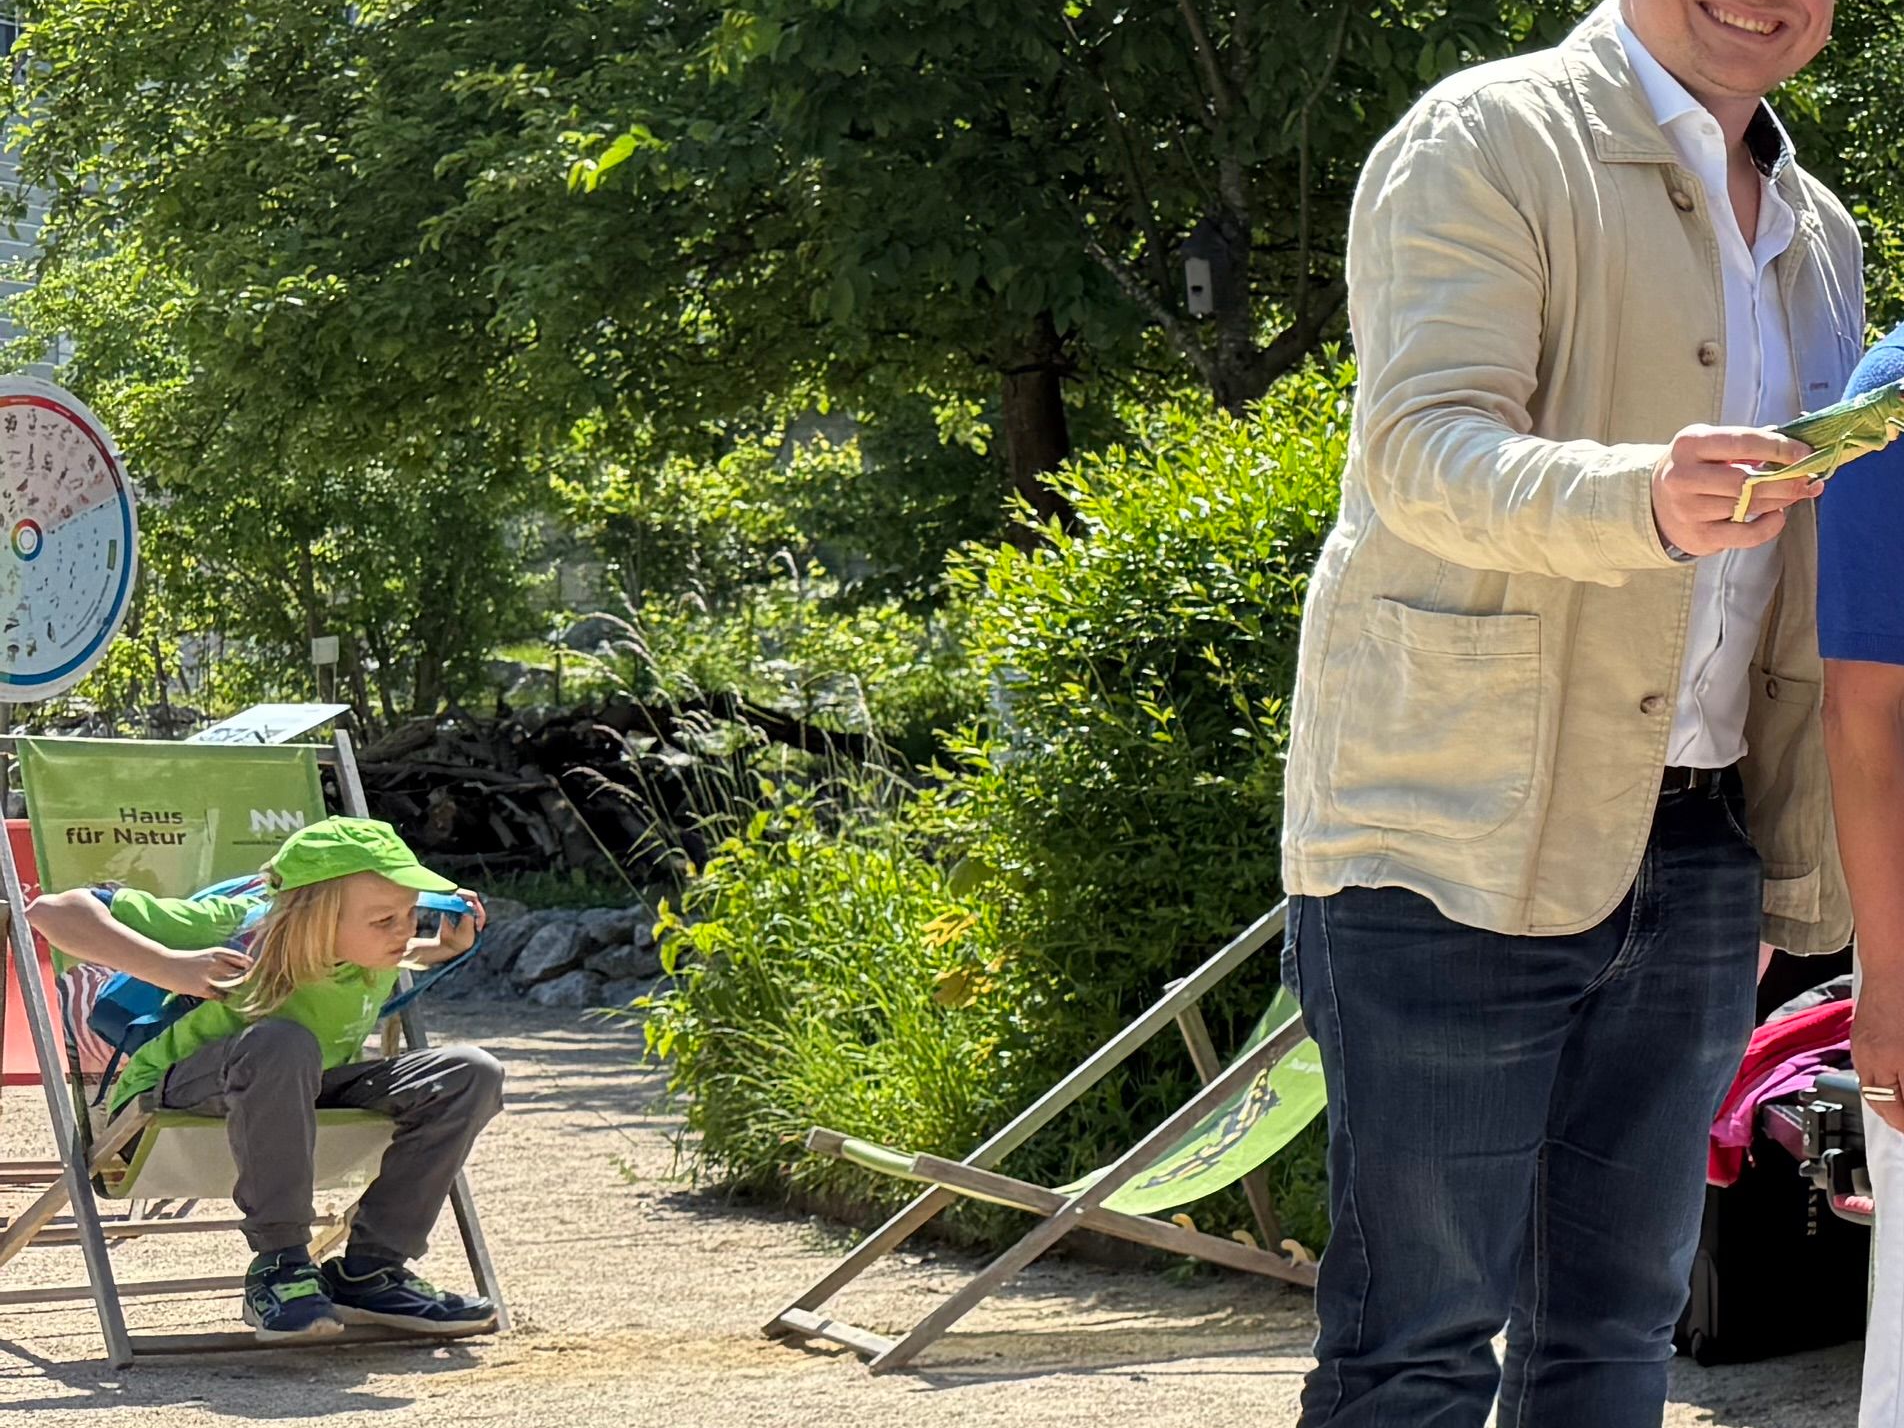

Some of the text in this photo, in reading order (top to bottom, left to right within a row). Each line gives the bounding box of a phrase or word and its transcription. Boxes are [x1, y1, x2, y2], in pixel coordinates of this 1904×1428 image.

[119, 807, 184, 825] Haus
[65, 826, 188, 846] für Natur
